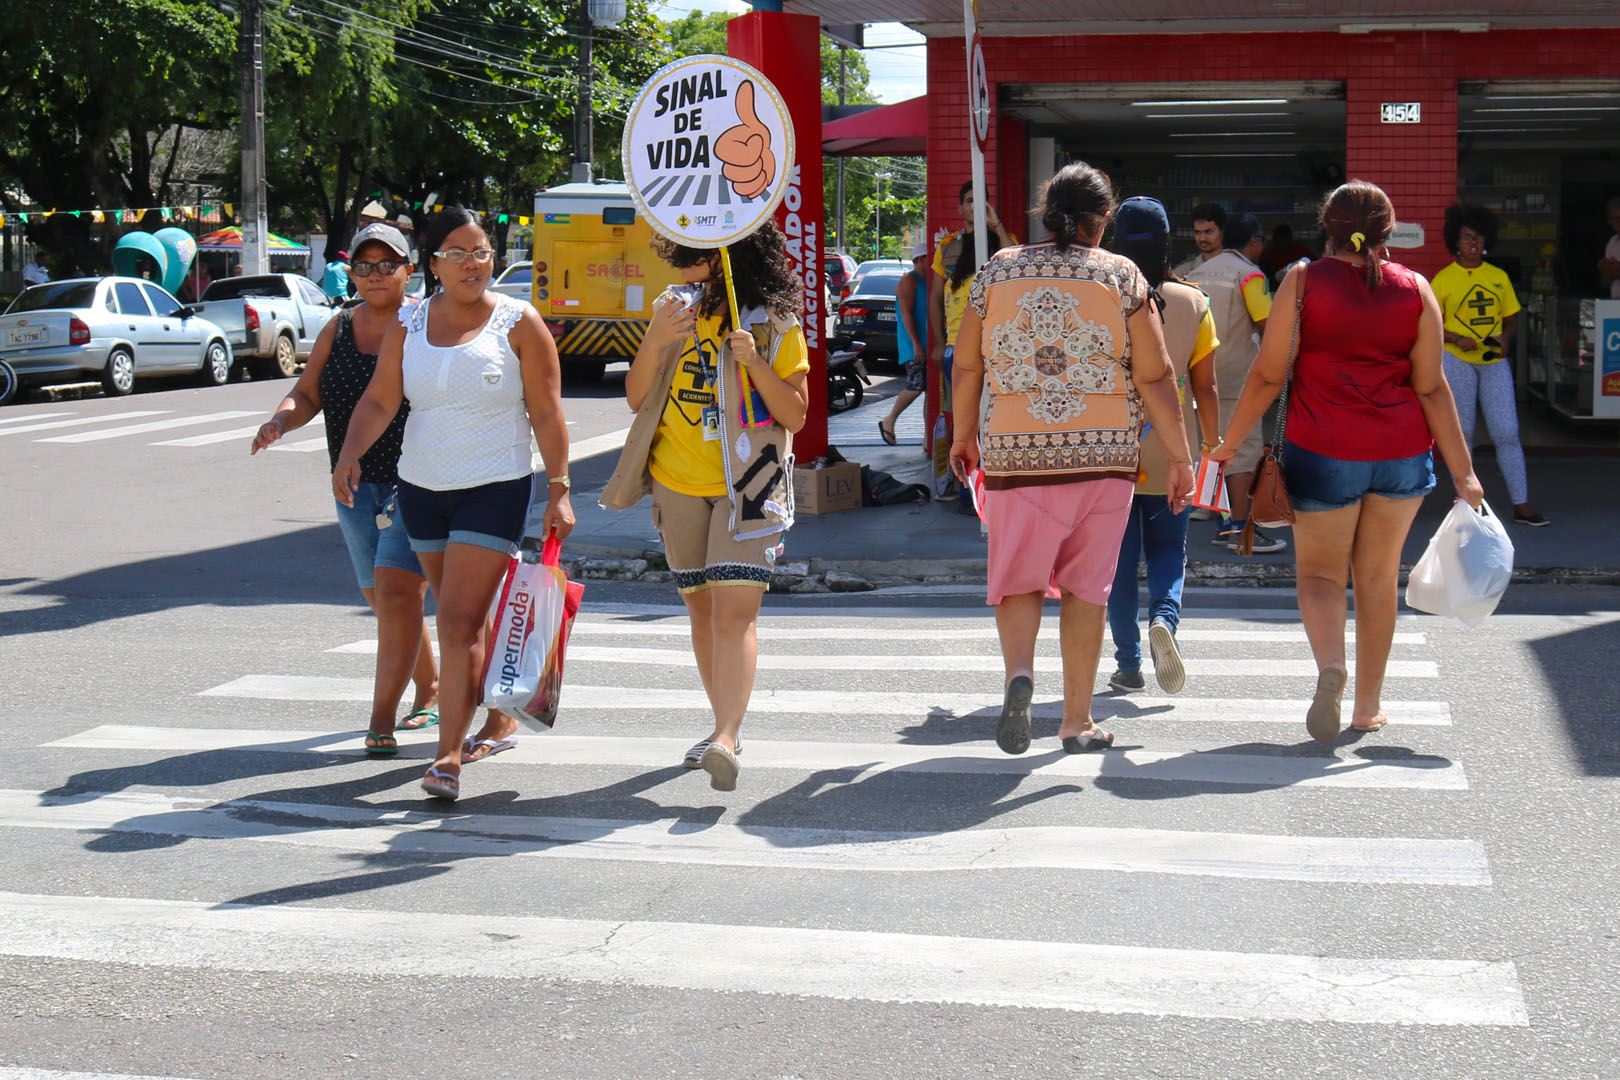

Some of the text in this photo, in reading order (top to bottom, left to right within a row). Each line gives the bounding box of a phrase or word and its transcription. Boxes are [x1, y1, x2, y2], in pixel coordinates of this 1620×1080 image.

[654, 69, 728, 118] SINAL
[674, 107, 702, 134] DE
[1382, 103, 1419, 122] 454
[646, 134, 710, 170] VIDA
[696, 215, 718, 225] SMTT
[804, 221, 819, 350] NACIONAL
[499, 591, 529, 696] supermoda
